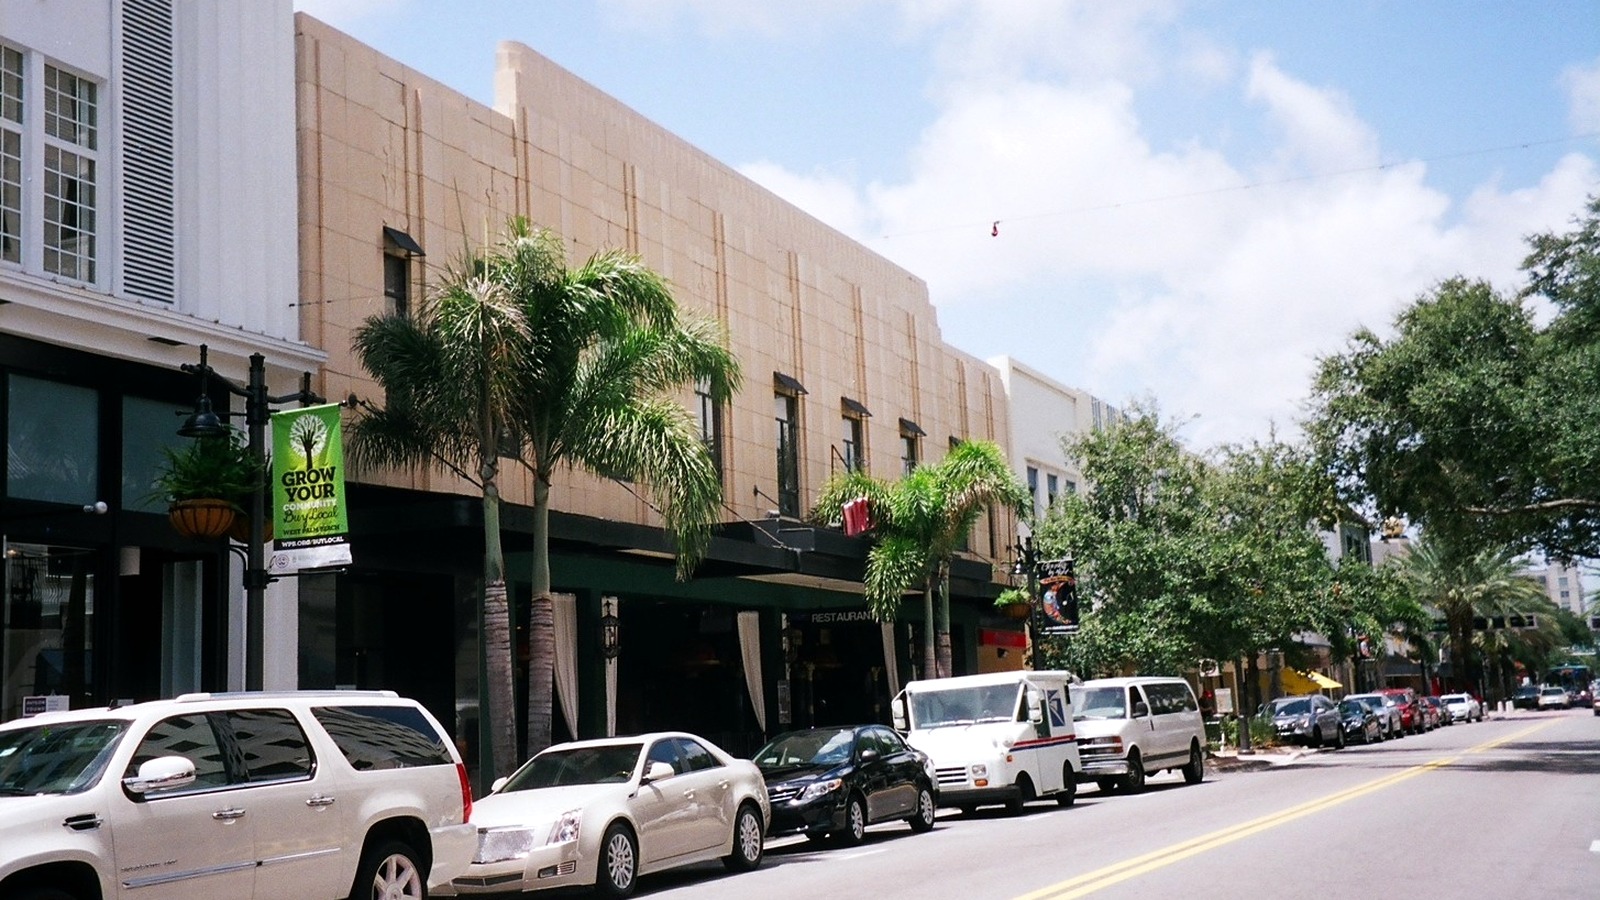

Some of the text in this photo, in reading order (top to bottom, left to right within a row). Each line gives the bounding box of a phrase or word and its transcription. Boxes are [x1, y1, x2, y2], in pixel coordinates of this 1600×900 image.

[282, 466, 336, 486] GROW
[285, 483, 335, 502] YOUR
[283, 505, 338, 529] Buy Local
